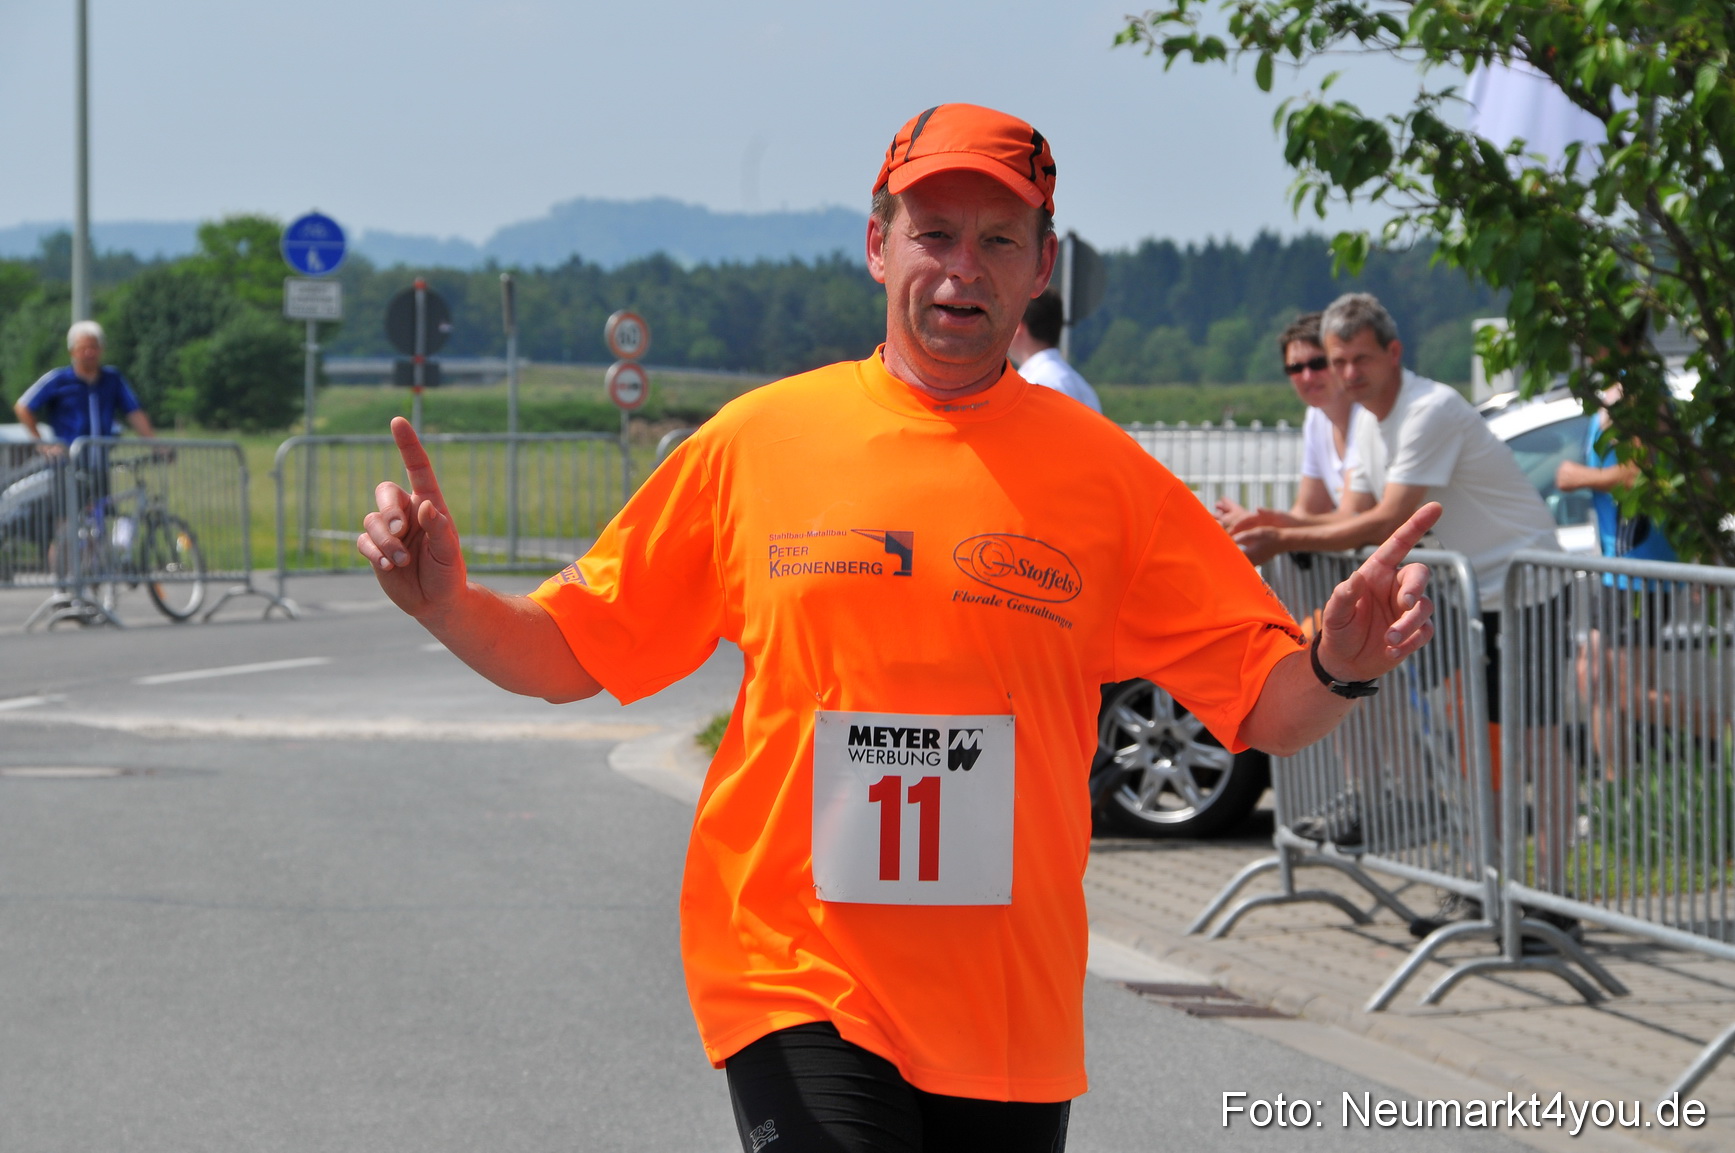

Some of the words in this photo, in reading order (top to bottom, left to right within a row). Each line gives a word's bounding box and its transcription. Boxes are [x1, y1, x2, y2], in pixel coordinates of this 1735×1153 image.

[769, 529, 847, 542] Stahlbau-Metallbau
[769, 544, 809, 560] PETER
[769, 559, 883, 579] KRONENBERG
[1015, 558, 1075, 593] Stoffels
[952, 590, 1003, 607] Florale
[1006, 597, 1073, 630] Gestaltungen
[848, 725, 941, 749] MEYER
[848, 748, 941, 767] WERBUNG
[868, 775, 941, 882] 11
